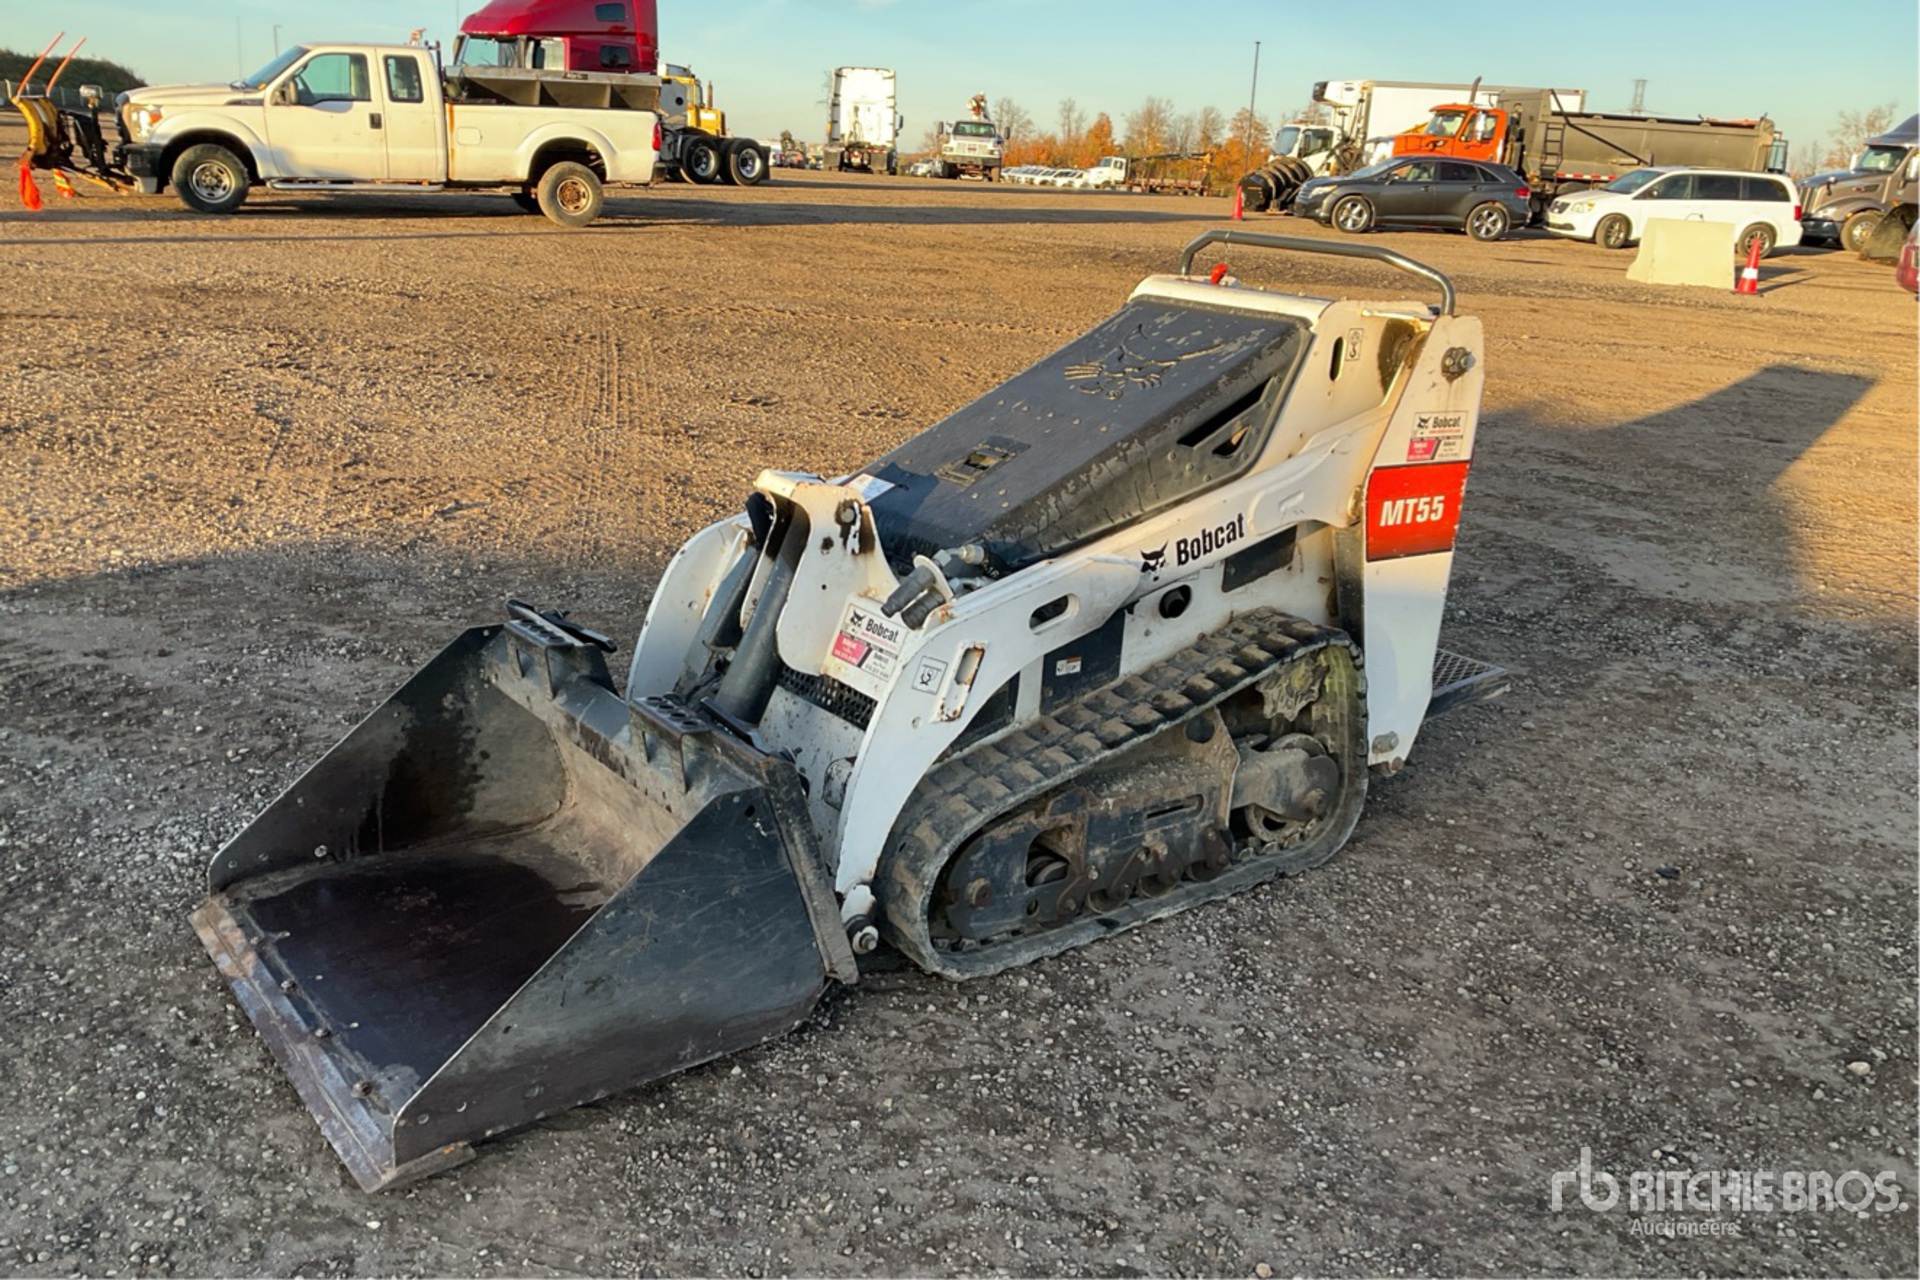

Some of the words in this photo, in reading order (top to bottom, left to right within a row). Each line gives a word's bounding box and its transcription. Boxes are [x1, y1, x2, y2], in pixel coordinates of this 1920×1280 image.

[1432, 416, 1461, 428] Bobcat
[1379, 495, 1445, 527] MT55
[1176, 512, 1244, 566] Bobcat
[865, 618, 899, 643] Bobcat
